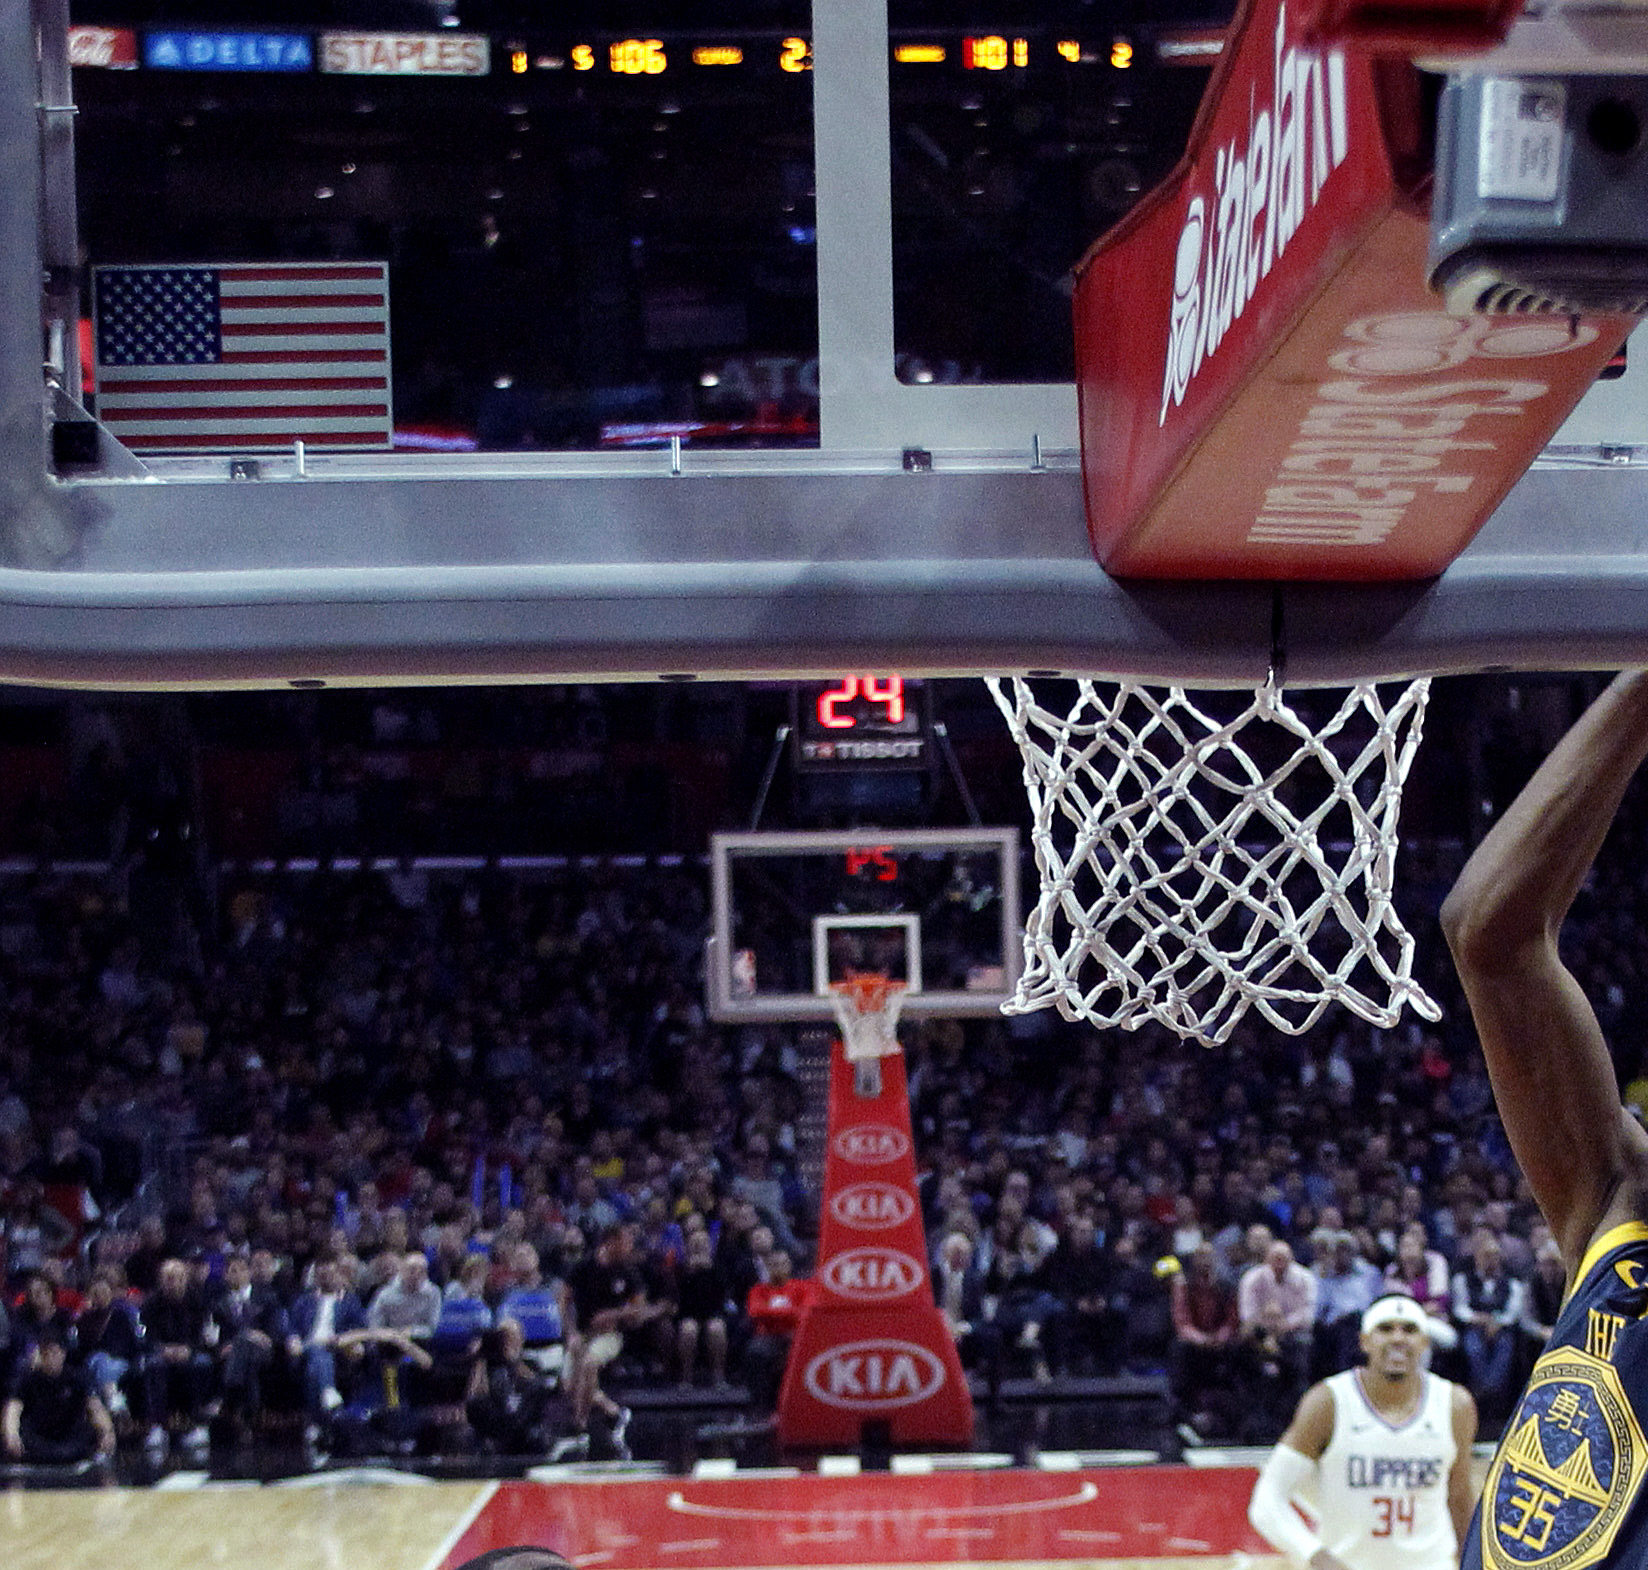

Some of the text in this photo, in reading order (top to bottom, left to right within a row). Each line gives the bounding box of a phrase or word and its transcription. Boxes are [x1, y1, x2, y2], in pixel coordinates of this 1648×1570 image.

[187, 38, 311, 65] DELTA
[325, 40, 485, 72] STAPLES
[816, 674, 905, 729] 24
[847, 1134, 894, 1152] KIA
[844, 1196, 900, 1217] KIA
[837, 1260, 907, 1286] KIA
[1585, 1307, 1626, 1362] THE
[829, 1356, 923, 1394] KIA
[1347, 1454, 1442, 1489] CLIPPERS
[1371, 1496, 1415, 1538] 34
[1499, 1477, 1562, 1552] 35
